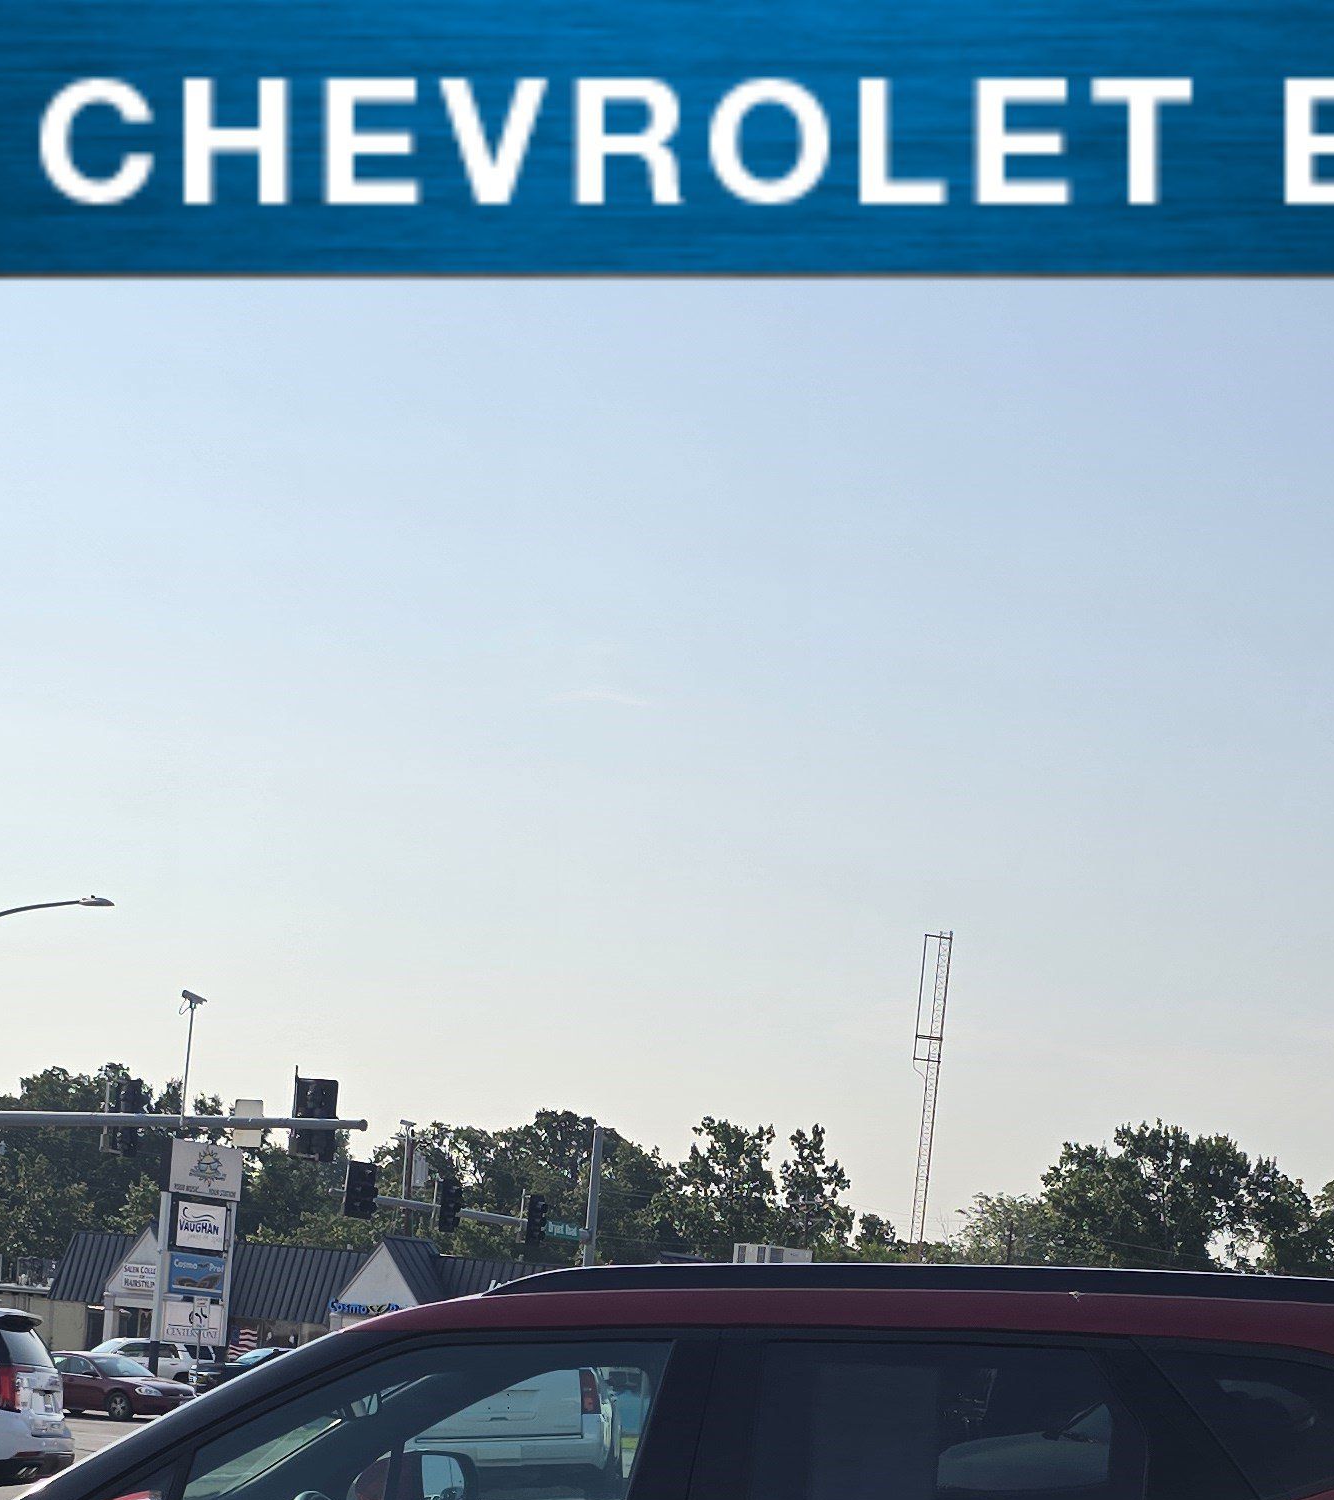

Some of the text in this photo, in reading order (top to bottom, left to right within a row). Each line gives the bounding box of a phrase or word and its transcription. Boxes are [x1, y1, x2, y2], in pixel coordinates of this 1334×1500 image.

[179, 1219, 220, 1235] VAUGHAN
[173, 1258, 198, 1270] Cosmo
[329, 1299, 367, 1315] Cosmo
